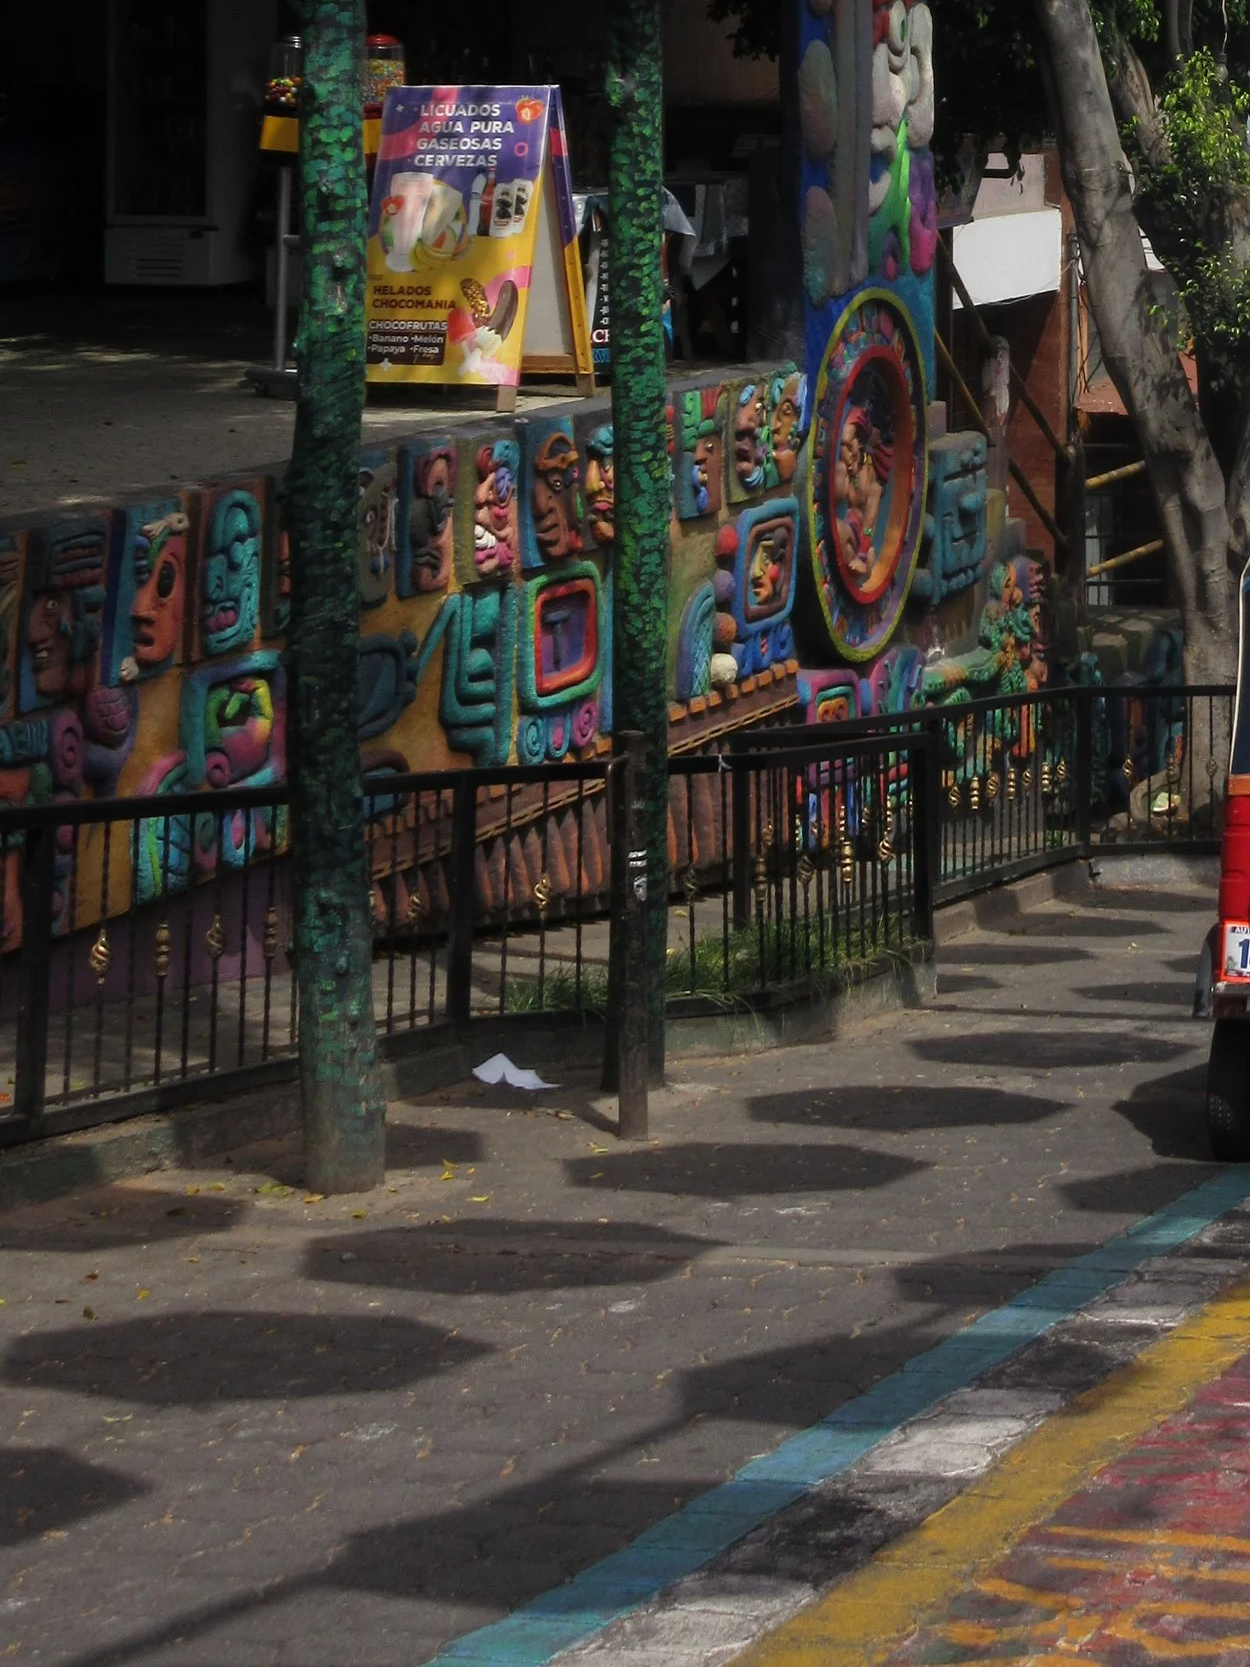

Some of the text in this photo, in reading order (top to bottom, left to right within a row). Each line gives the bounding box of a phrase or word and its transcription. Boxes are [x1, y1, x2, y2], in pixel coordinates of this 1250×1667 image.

[420, 103, 500, 117] LICUADOS
[418, 121, 514, 134] AGUA PURA
[416, 138, 502, 150] GASEOSAS
[414, 154, 497, 167] CERVEZAS
[373, 286, 432, 296] HELADOS
[372, 299, 456, 310] CHOCOMANIA
[369, 320, 448, 331] CHOCOFRUTAS
[371, 334, 444, 343] Banano Melón
[370, 345, 440, 354] Papaya Fresa
